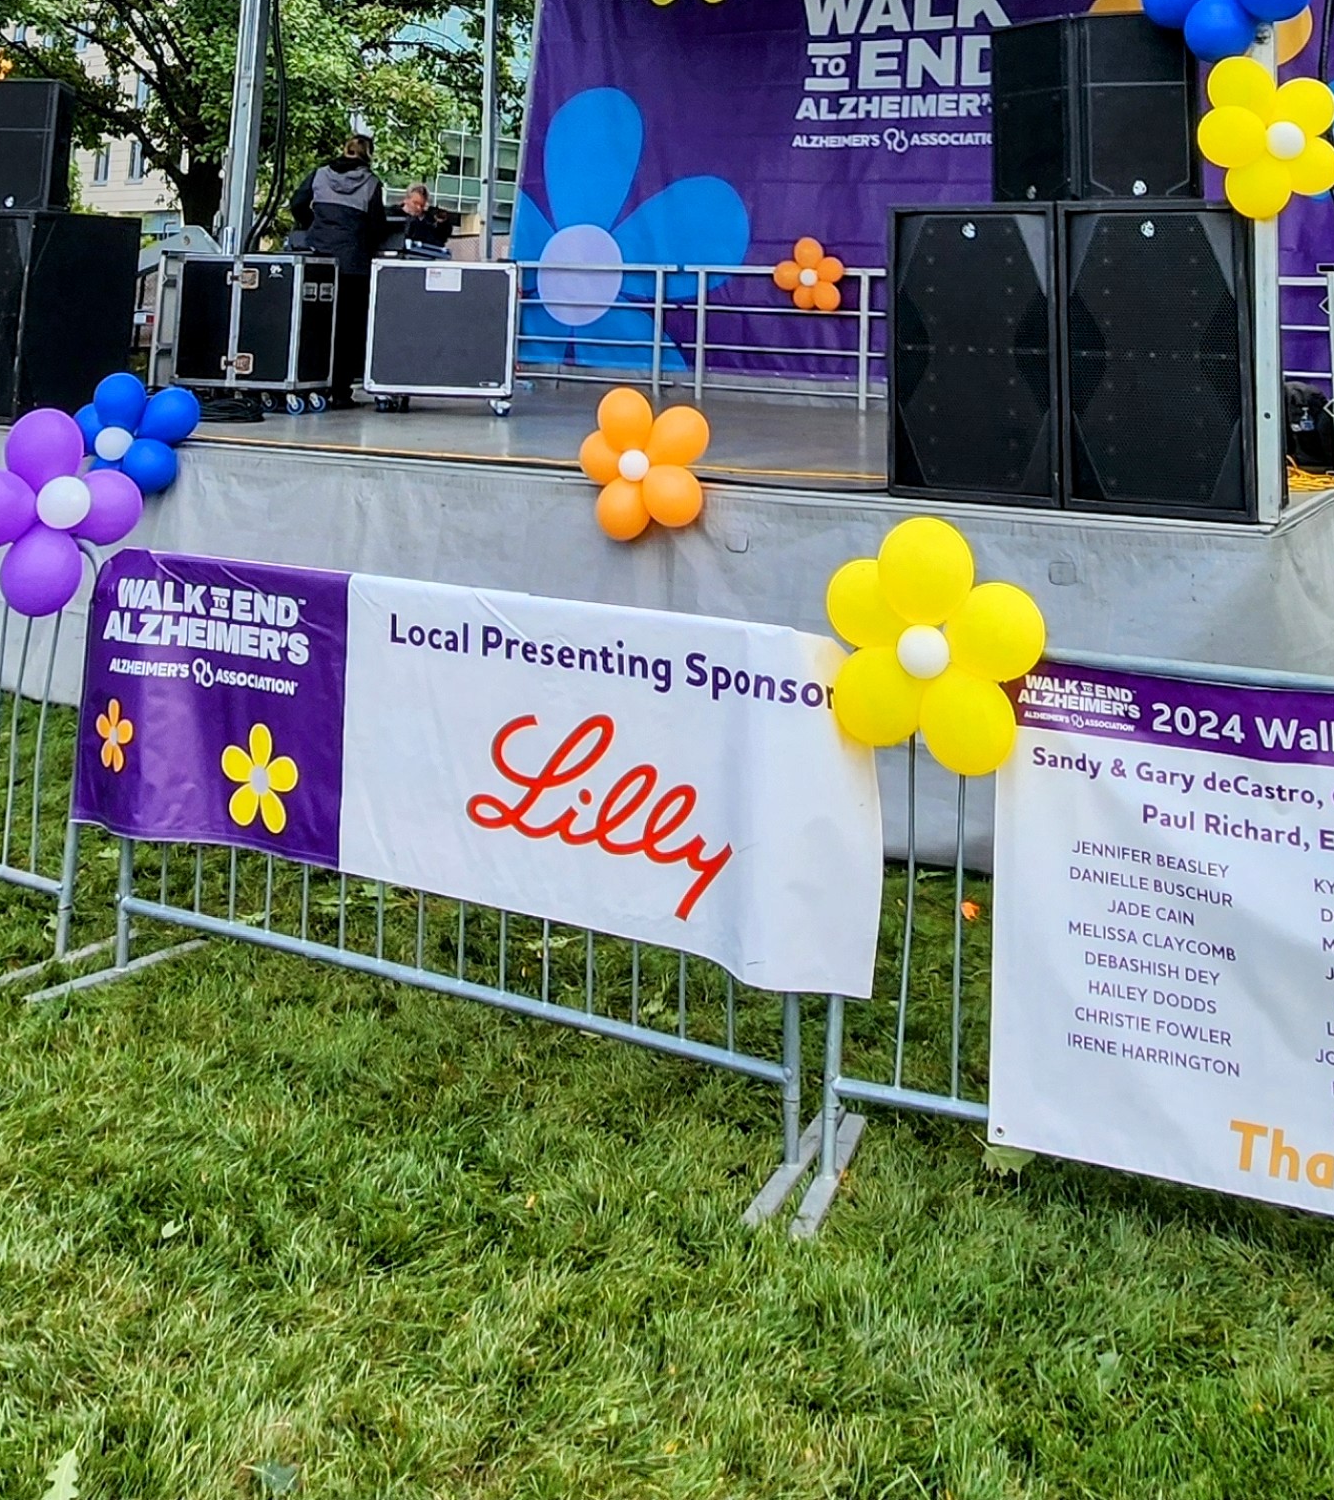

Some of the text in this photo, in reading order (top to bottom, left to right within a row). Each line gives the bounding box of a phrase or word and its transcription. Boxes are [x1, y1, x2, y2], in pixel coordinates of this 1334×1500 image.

[794, 93, 993, 121] ALZHEIMER'
[792, 132, 880, 148] ALZHEIMER'S
[117, 578, 299, 628] WALK END
[103, 611, 310, 666] ALZHEIMER'S
[390, 612, 468, 654] Local
[481, 624, 670, 692] Presenting
[109, 658, 295, 696] ALZHEIMER'S ASSOCIATION
[1025, 674, 1134, 703] WALK END
[1018, 689, 1141, 719] ALZHEIMER'S
[1151, 702, 1246, 745] 2024
[1084, 718, 1135, 732] ASSOCIATION
[1032, 746, 1102, 780] Sandy
[1110, 758, 1127, 778] &
[1135, 762, 1195, 794] Gary
[1203, 771, 1324, 809] deCastro,
[466, 713, 733, 921] Lilly
[1142, 803, 1195, 831] Paul
[1204, 813, 1311, 851] Richard,
[1072, 840, 1230, 878] JENNIFER BEASLEY
[1069, 866, 1233, 908] DANIELLE BUSCHUR
[1107, 899, 1195, 926] JADE CAIN
[1068, 921, 1236, 961] MELISSA CLAYCOMB
[1084, 950, 1221, 986] DEBASHISH DEY
[1088, 979, 1217, 1014] HAILEY DODDS
[1074, 1006, 1232, 1047] CHRISTIE FOWLER
[1067, 1032, 1241, 1078] IRENE HARRINGTON
